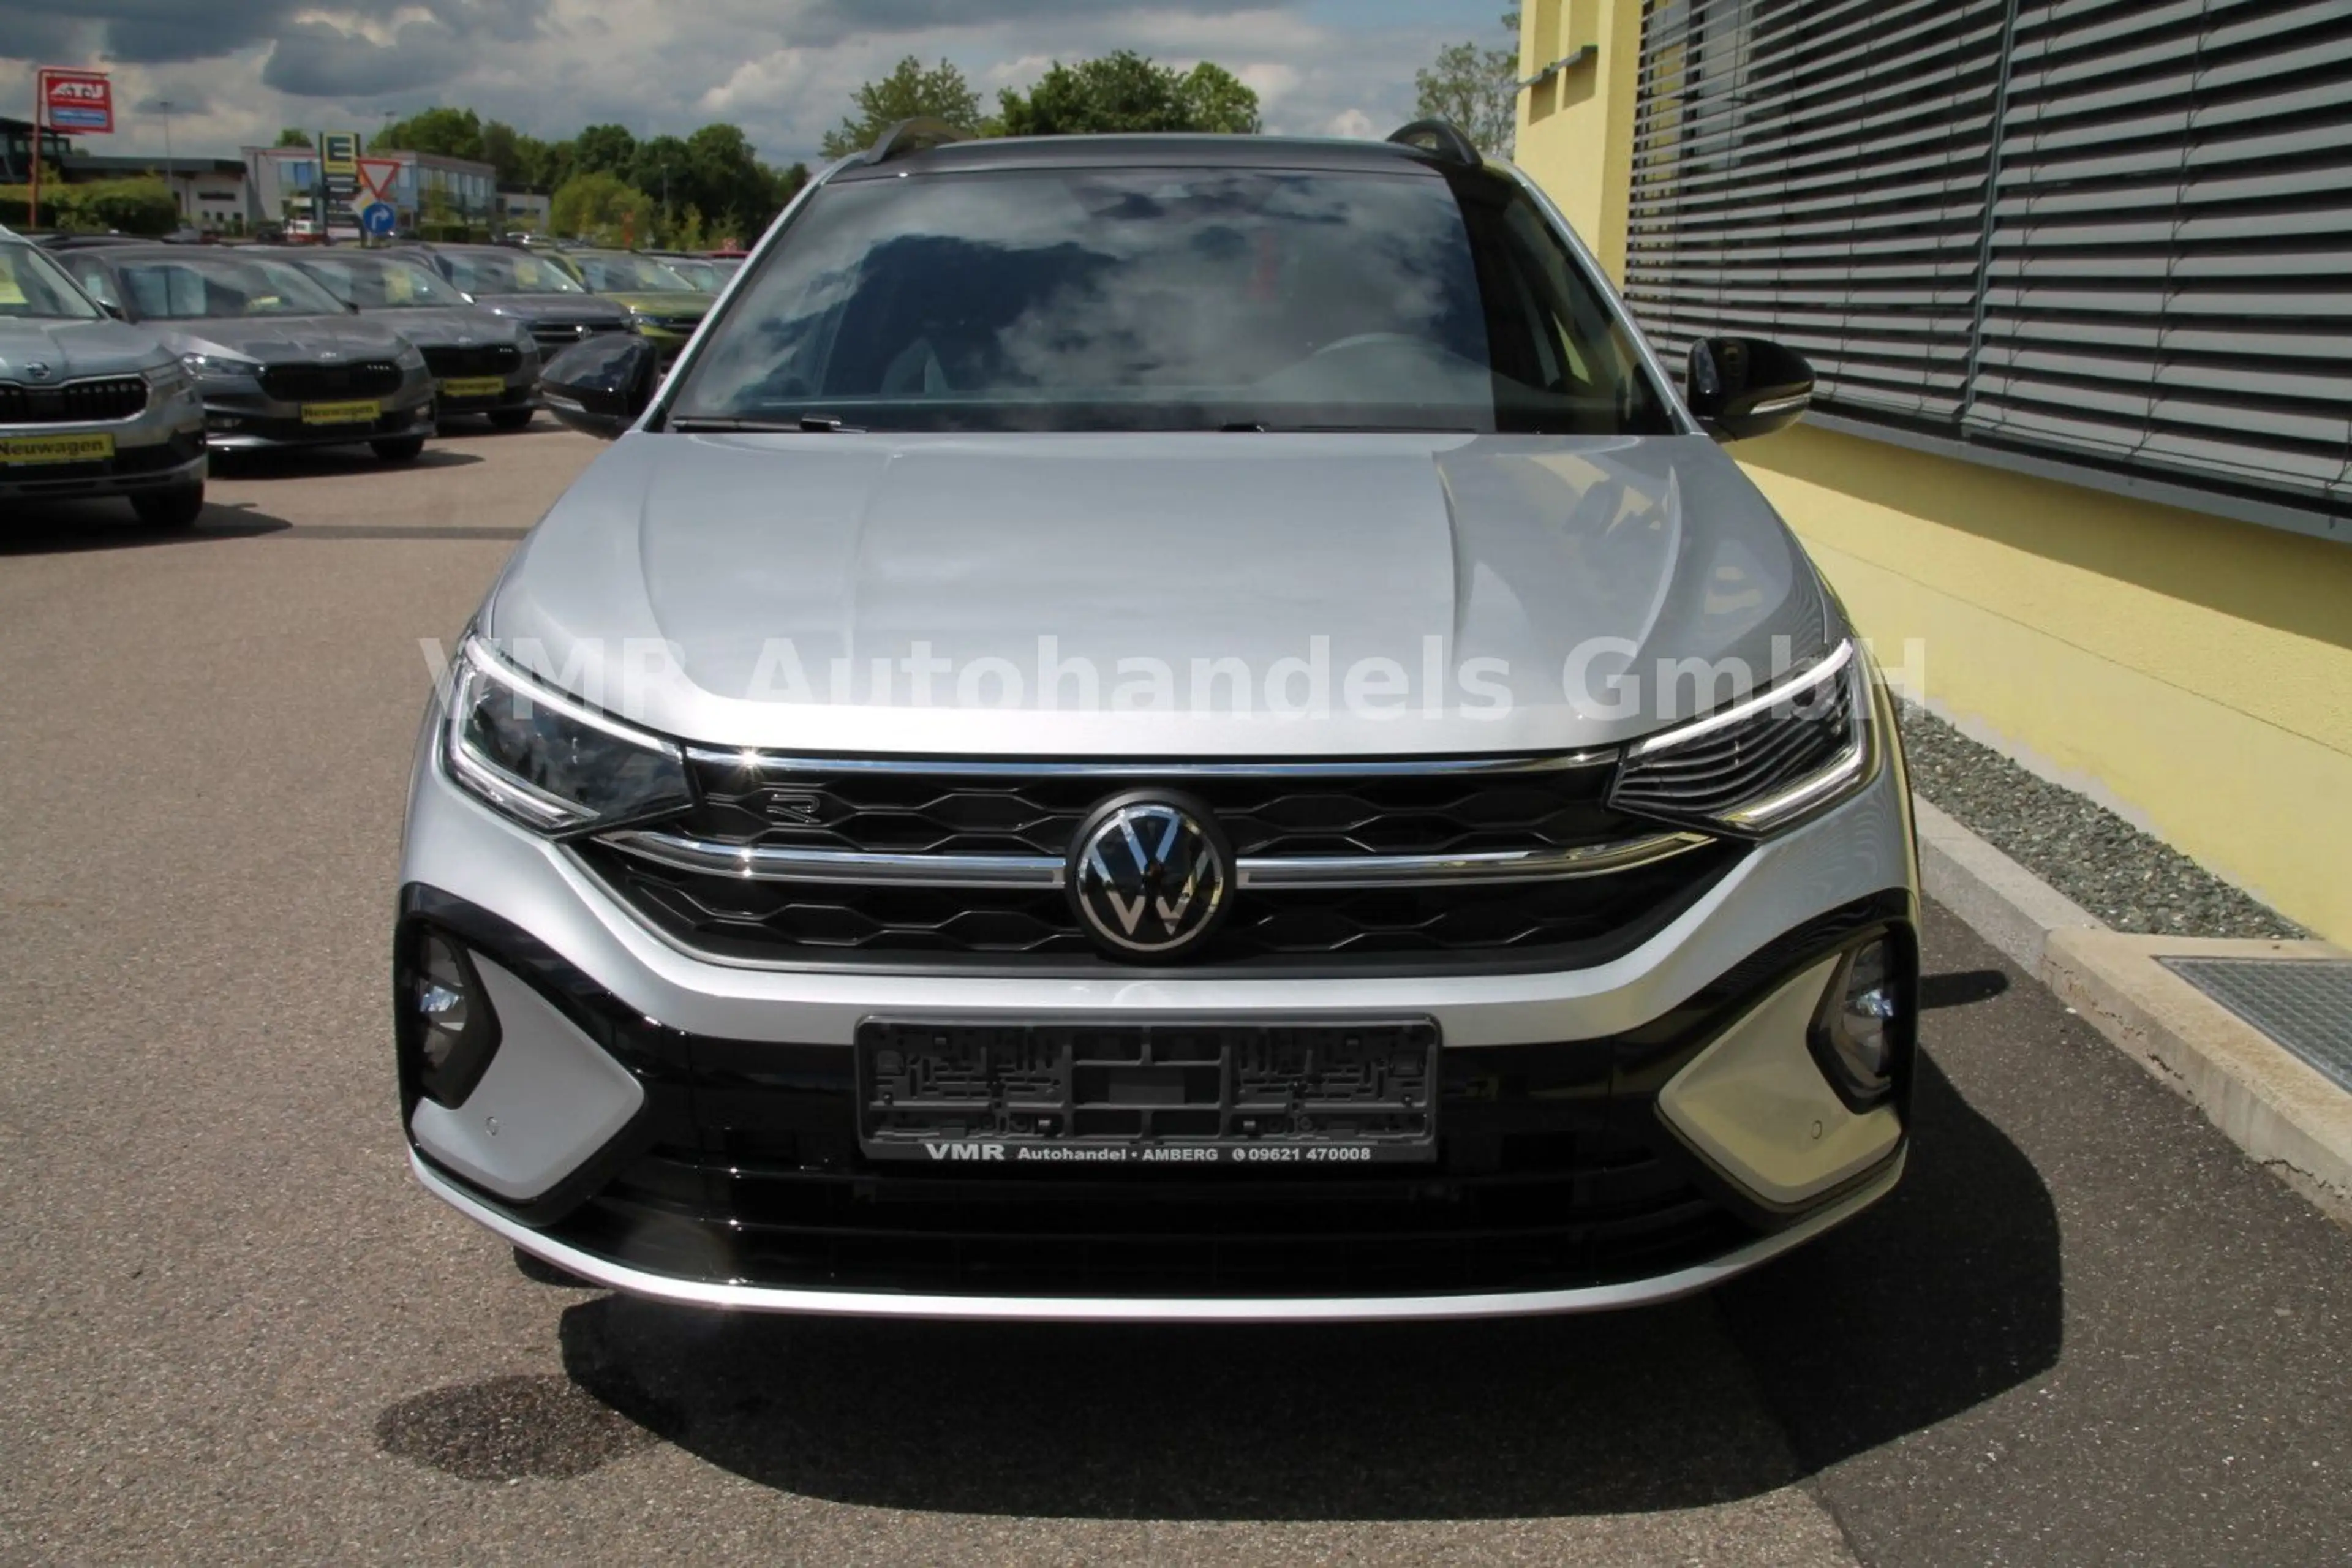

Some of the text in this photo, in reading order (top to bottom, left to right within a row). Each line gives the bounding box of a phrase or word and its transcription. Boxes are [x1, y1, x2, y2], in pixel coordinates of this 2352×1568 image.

[925, 1143, 1371, 1161] VMR Autohandel AMBERG 09621 470008
